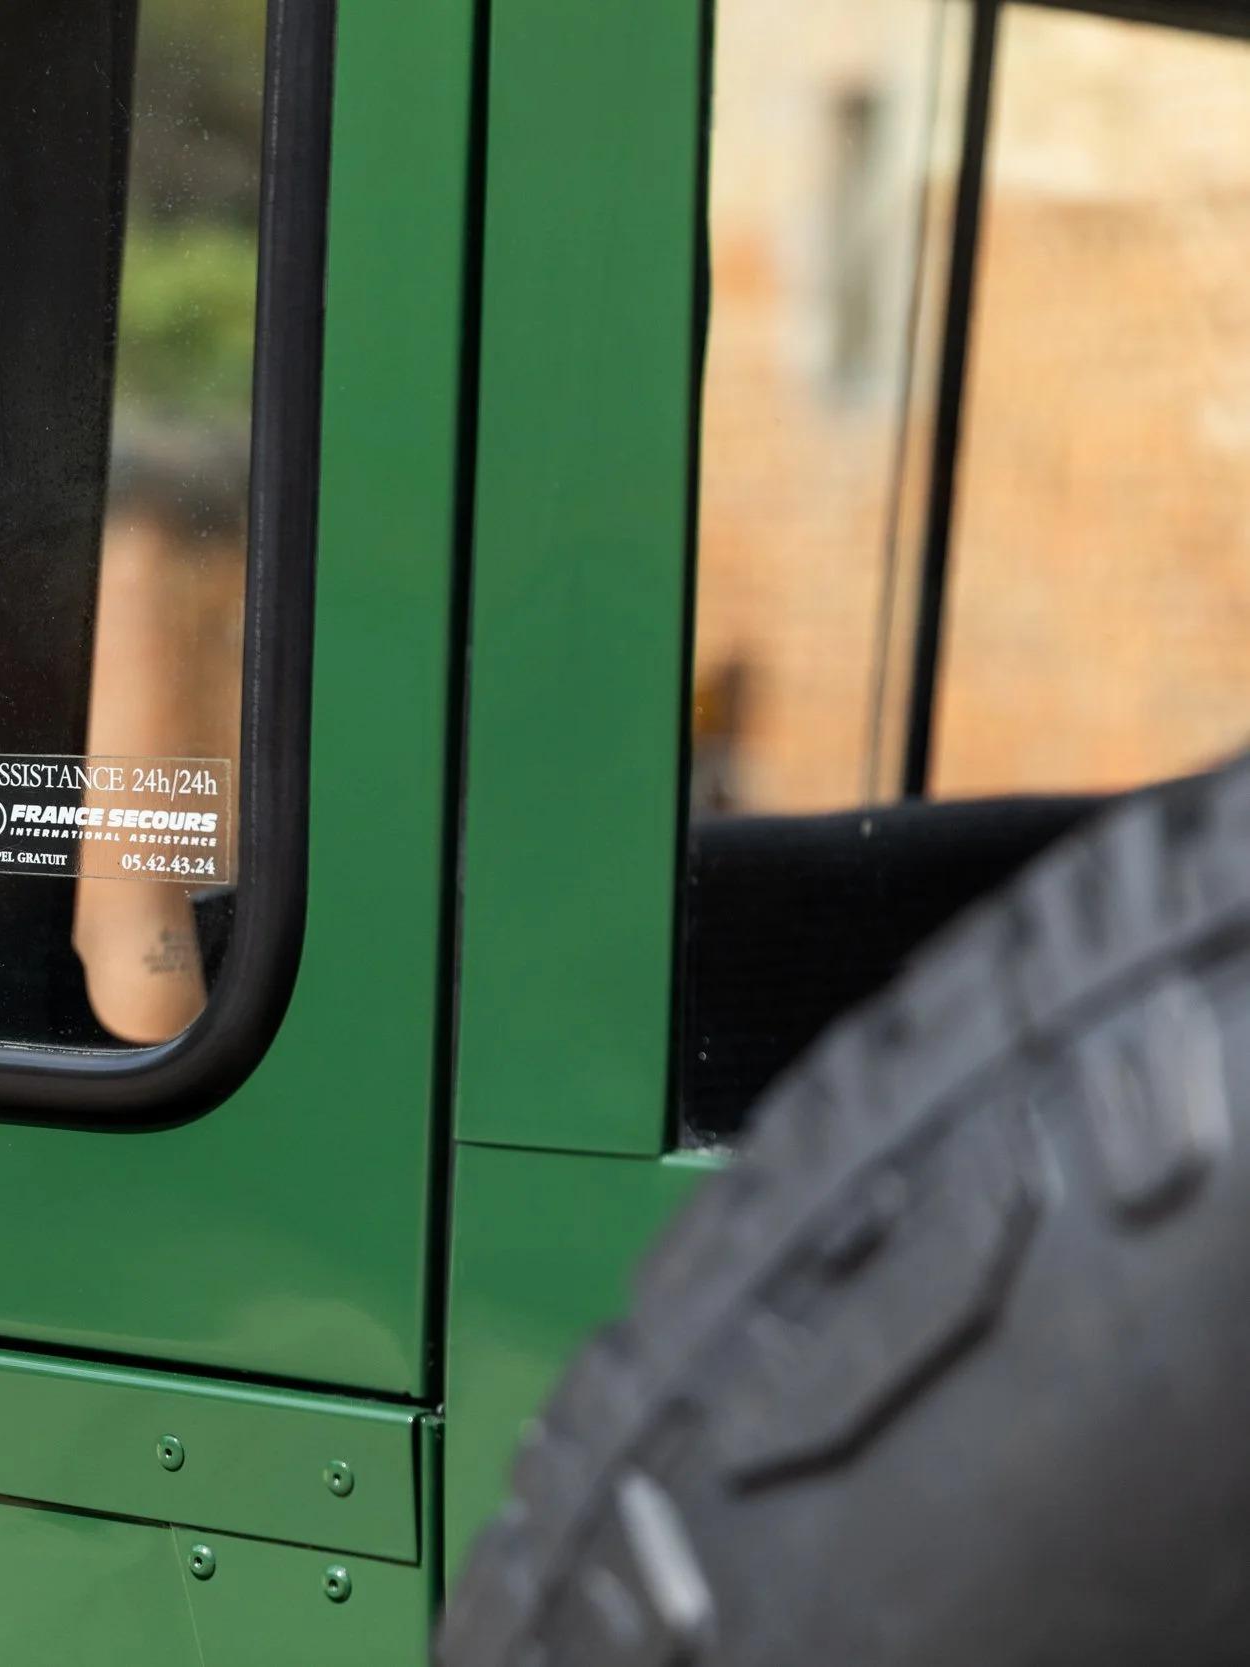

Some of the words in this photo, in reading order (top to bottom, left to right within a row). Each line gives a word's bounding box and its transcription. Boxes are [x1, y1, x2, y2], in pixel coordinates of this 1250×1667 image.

[131, 768, 218, 800] 24h/24h
[10, 804, 103, 826] FRANCE
[107, 809, 218, 832] SECOURS
[10, 827, 120, 842] INTERNATIONAL
[129, 834, 217, 847] ASSISTANCE
[17, 852, 68, 866] GRATUIT
[121, 853, 216, 875] 05.42.43.24
